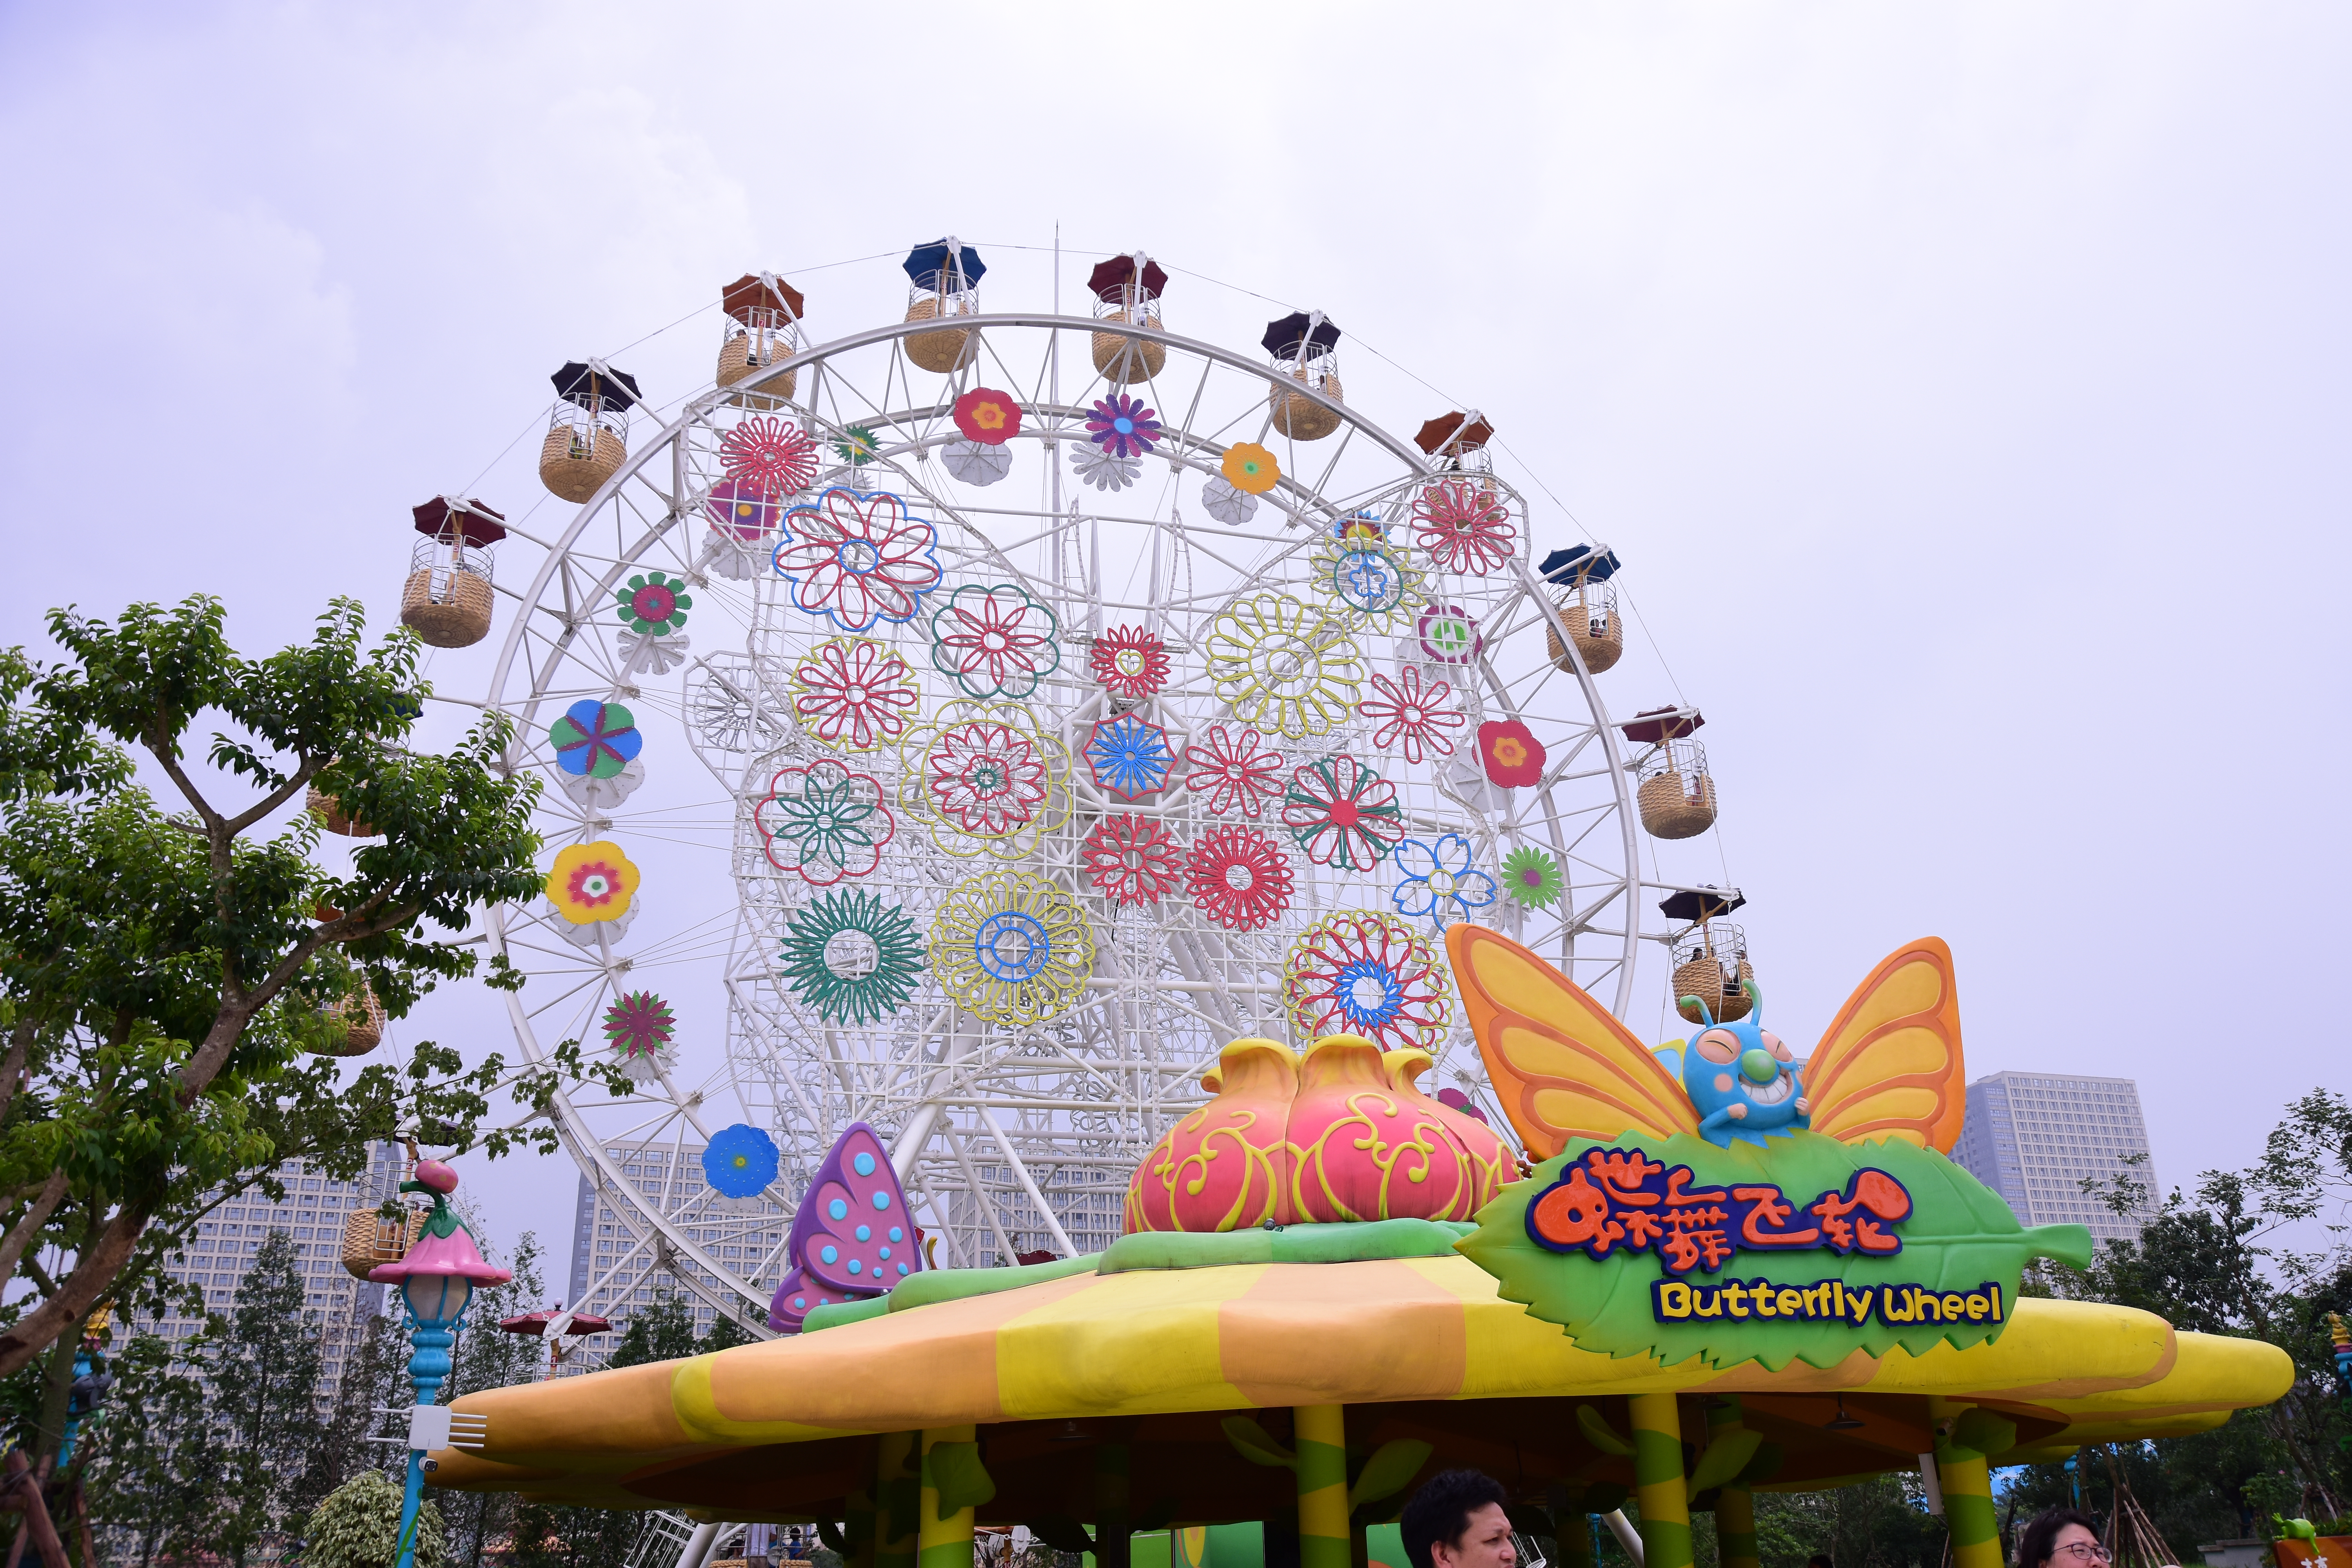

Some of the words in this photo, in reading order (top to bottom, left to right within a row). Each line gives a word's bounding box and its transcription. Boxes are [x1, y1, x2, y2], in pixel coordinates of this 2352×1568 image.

[406, 1159, 413, 1168] 2
[1534, 1151, 1909, 1271] 蝶舞飞轮
[1660, 1282, 1873, 1323] Butterfly
[1884, 1287, 2000, 1322] Wheel
[552, 1357, 556, 1366] 1
